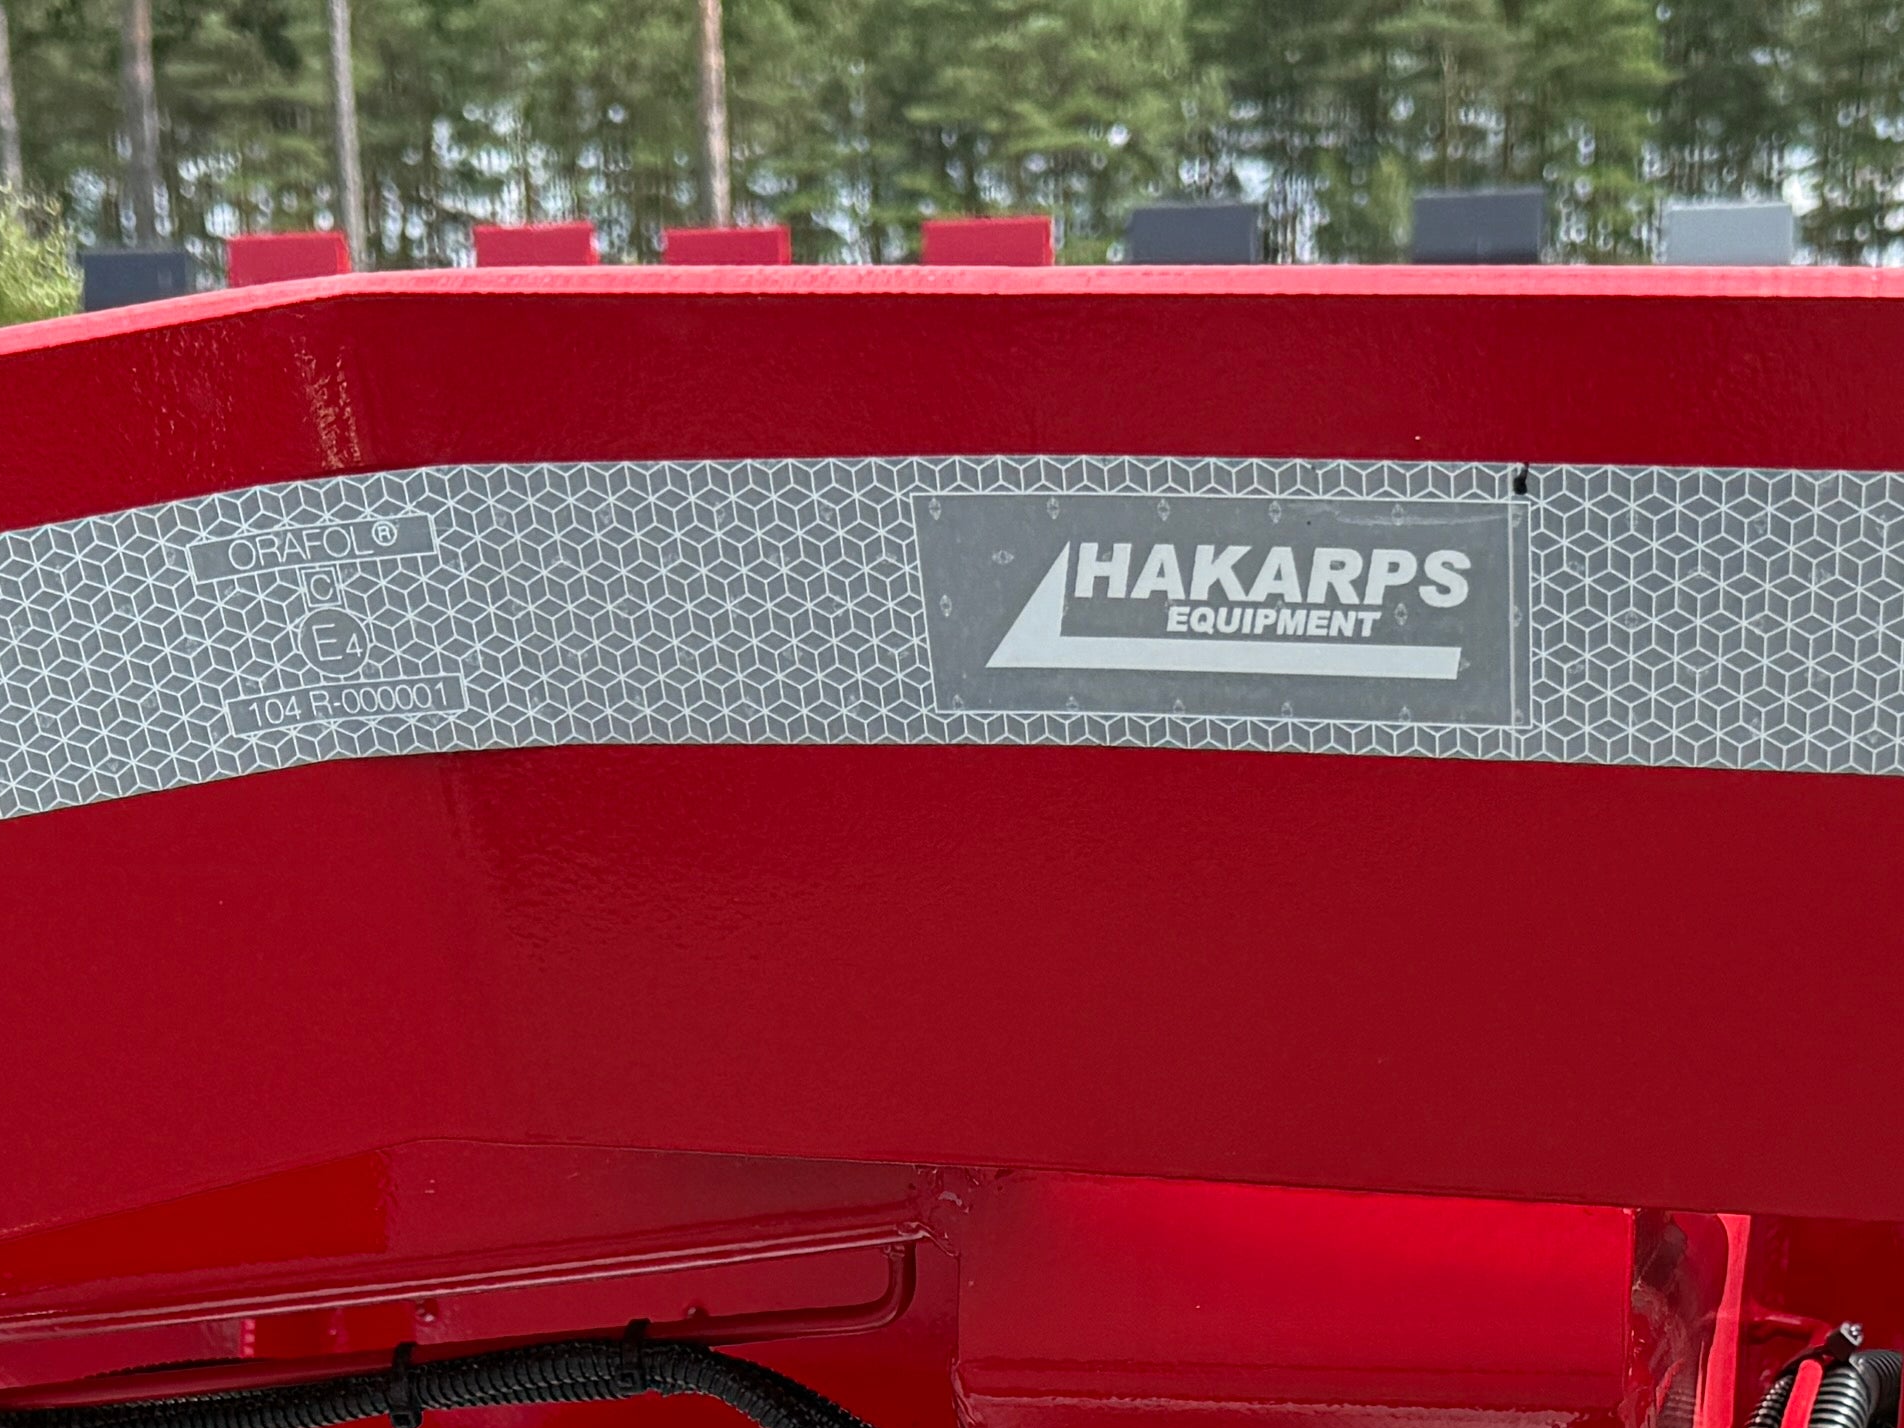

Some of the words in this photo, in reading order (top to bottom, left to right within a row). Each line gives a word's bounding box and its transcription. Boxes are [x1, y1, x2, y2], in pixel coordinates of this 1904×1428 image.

[310, 574, 333, 600] C
[1074, 541, 1472, 608] HAKARPS
[1166, 606, 1382, 637] EQUIPMENT
[249, 696, 301, 727] 104
[309, 681, 447, 716] R-000001
